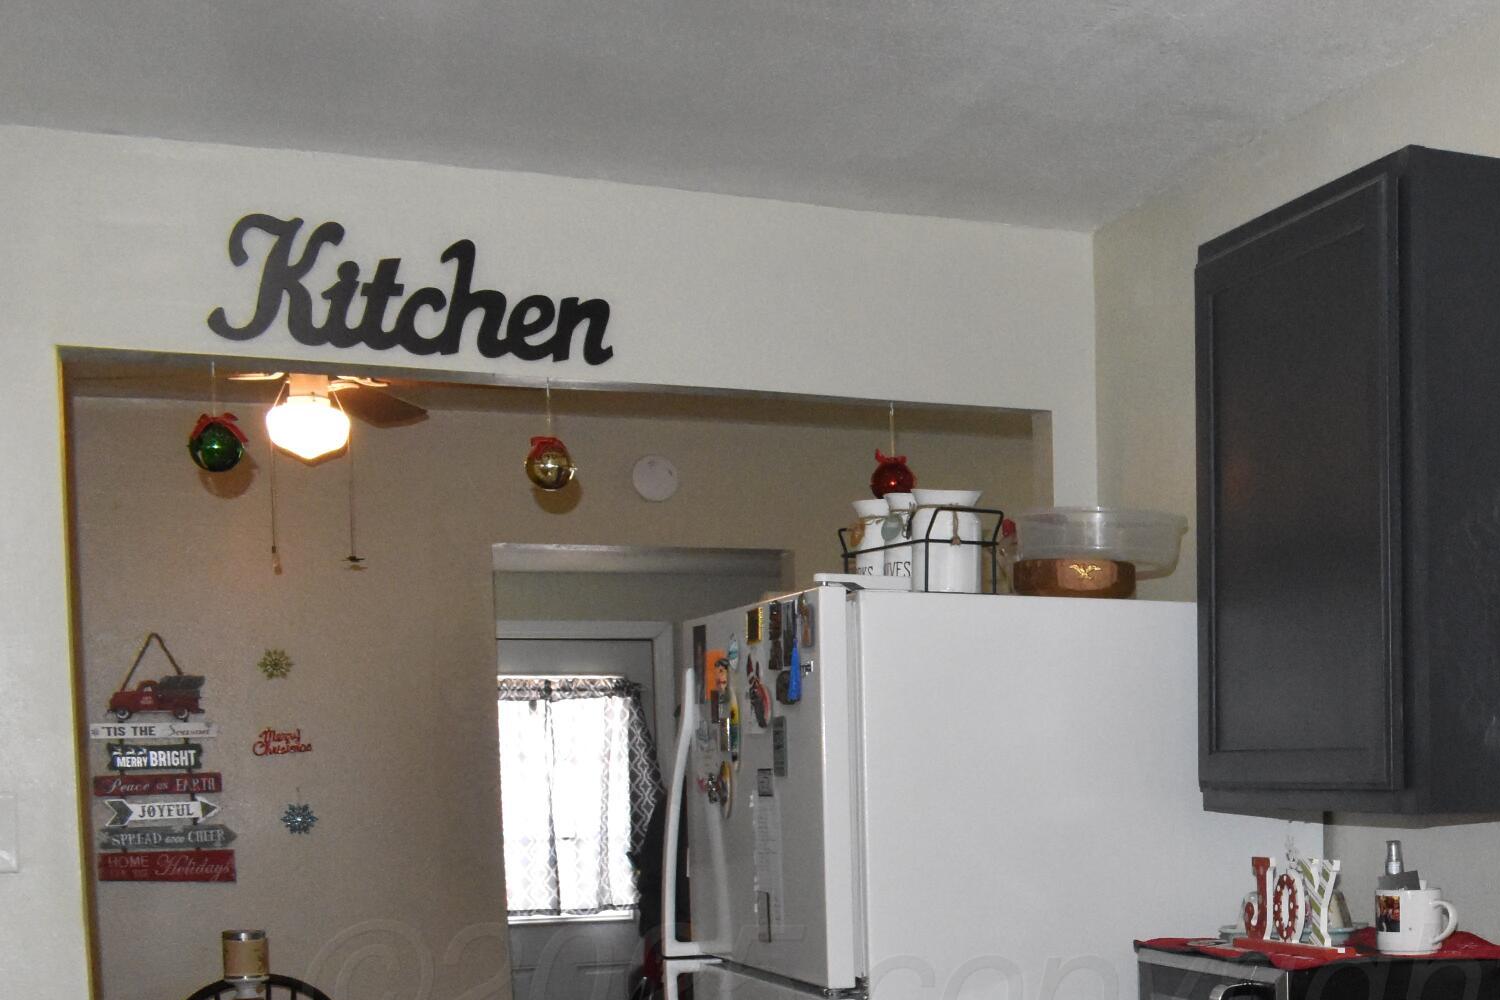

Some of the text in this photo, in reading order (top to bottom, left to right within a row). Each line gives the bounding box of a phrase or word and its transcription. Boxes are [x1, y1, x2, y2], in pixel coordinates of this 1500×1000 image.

[207, 213, 614, 366] Kitchen
[131, 726, 156, 736] THE
[116, 750, 197, 768] MERRY BRIGHT
[107, 778, 150, 794] Peace
[175, 777, 216, 792] EARTH
[138, 804, 194, 818] JOYFUL
[1244, 856, 1340, 947] JOY
